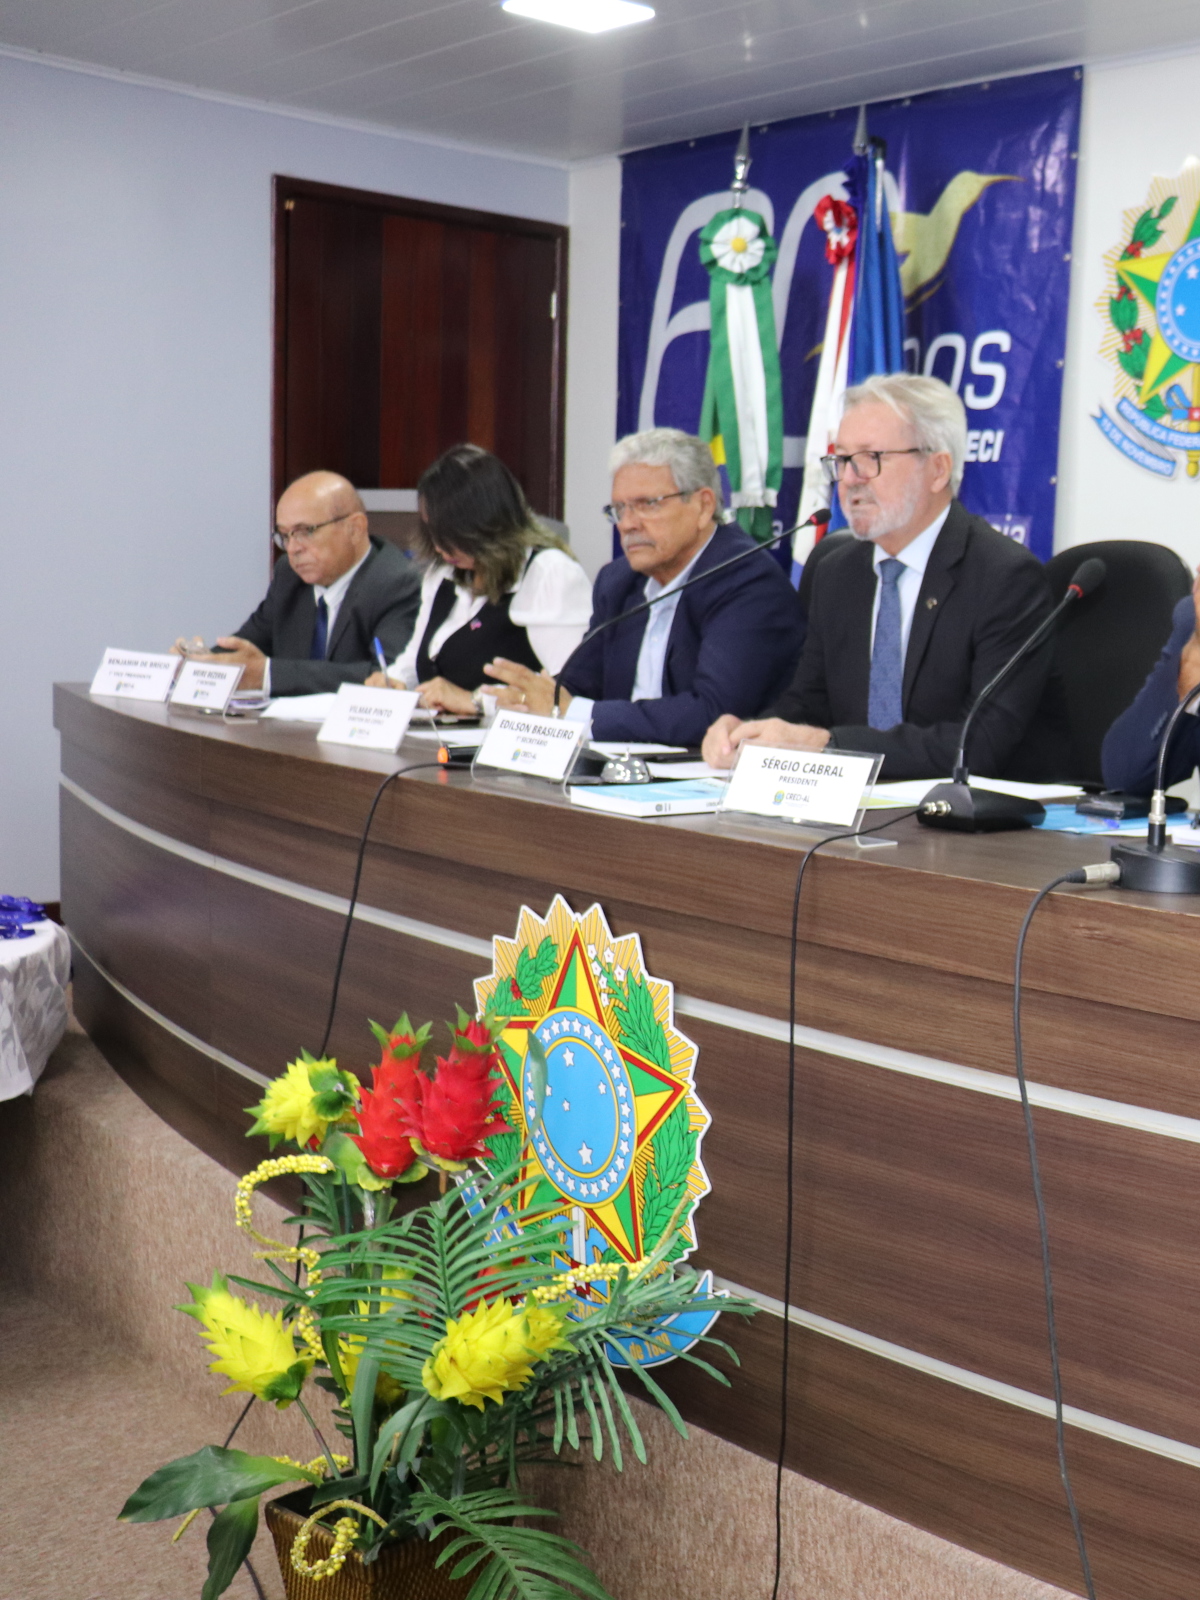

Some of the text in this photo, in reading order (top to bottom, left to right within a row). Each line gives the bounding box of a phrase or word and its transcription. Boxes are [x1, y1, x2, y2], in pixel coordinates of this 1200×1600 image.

[499, 719, 575, 740] EDILSON BRASILEIRO
[761, 755, 845, 778] SÉRGIO CABRAL
[778, 775, 819, 787] PRESIDENTE
[785, 792, 810, 803] CRECI-AL
